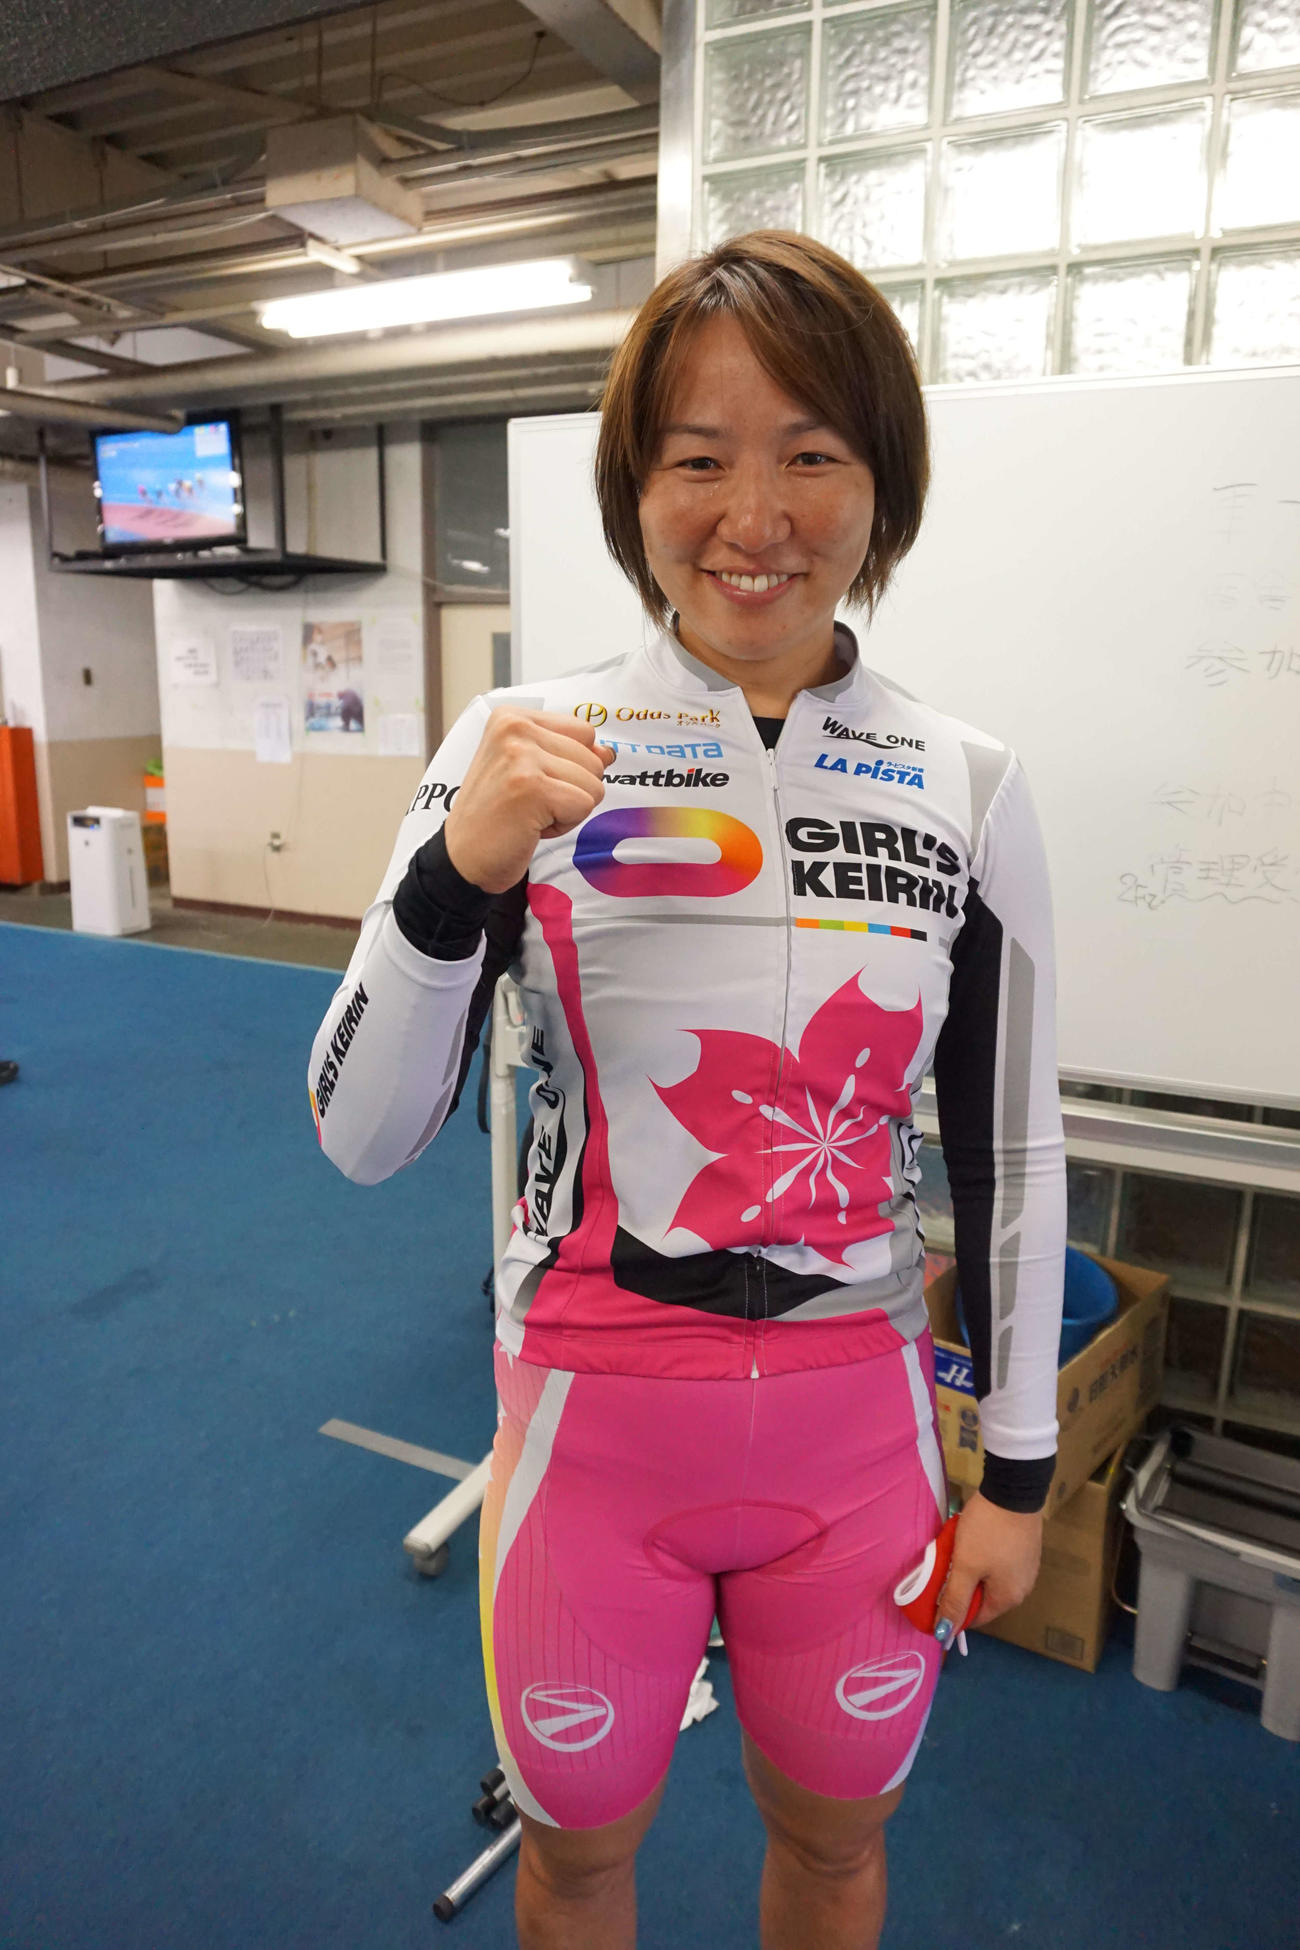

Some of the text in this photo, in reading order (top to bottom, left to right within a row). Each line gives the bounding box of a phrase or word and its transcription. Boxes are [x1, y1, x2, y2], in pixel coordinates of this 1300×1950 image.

[814, 753, 848, 774] LA
[822, 716, 925, 752] WAVE ONE
[785, 817, 961, 876] GIRL'S
[791, 860, 959, 919] KEIRIN
[316, 980, 369, 1118] GIRL'S KEIRIN
